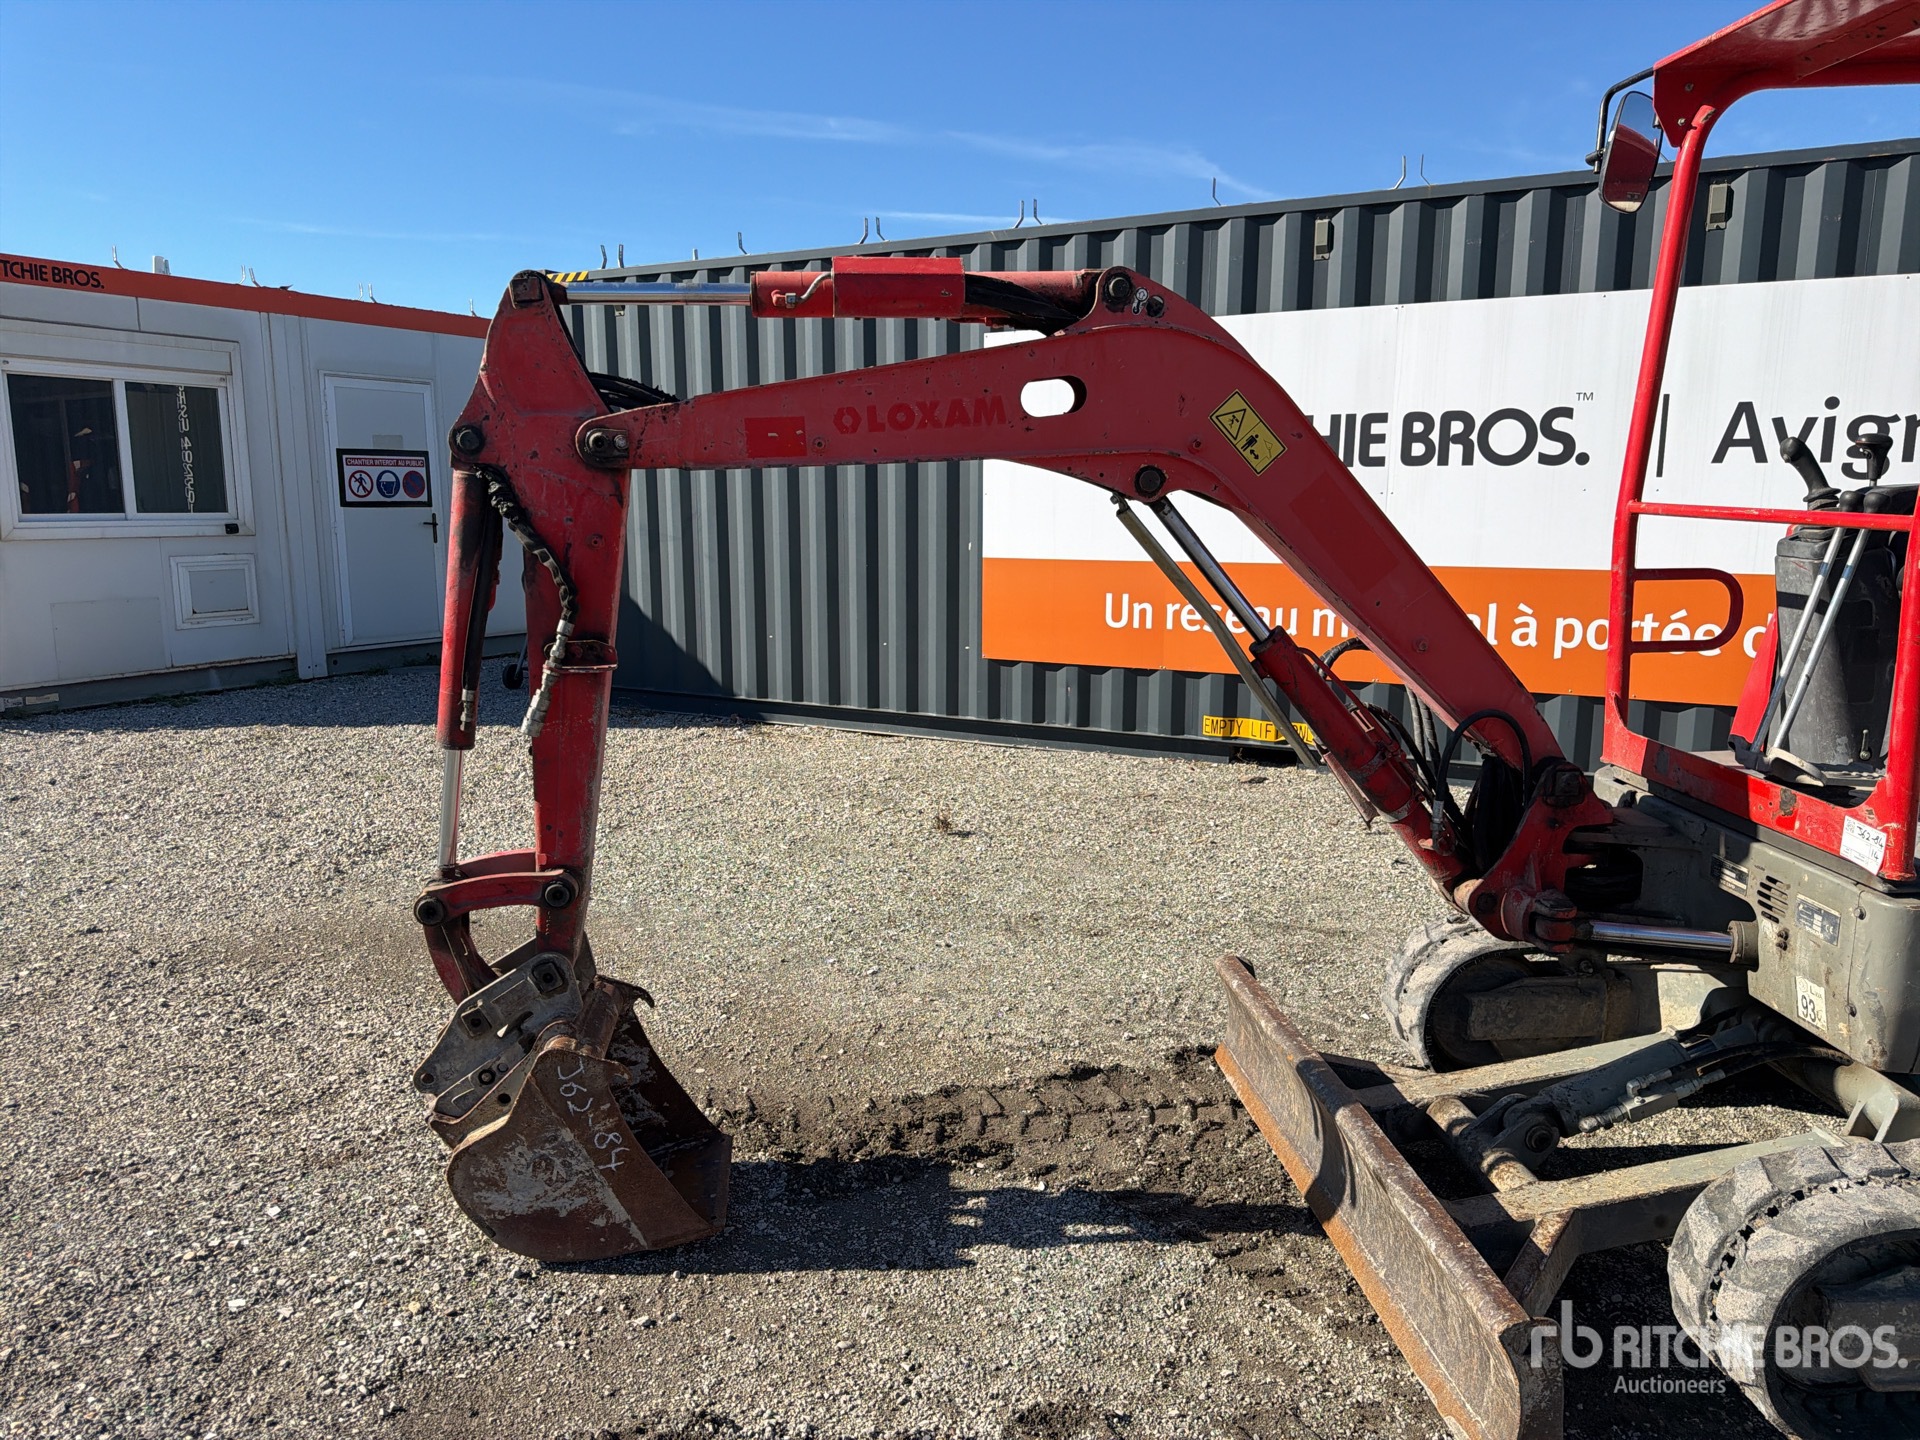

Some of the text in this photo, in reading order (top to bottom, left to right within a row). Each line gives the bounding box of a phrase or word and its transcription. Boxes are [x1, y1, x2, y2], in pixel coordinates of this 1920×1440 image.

[51, 266, 105, 290] BROS.
[866, 395, 1007, 433] LOXAM
[1399, 406, 1591, 467] BROS.
[374, 459, 397, 467] INTERDIT
[1104, 592, 1153, 630] Un
[1510, 602, 1538, 648] à
[1204, 717, 1244, 736] EMPTY
[1801, 994, 1817, 1022] 93
